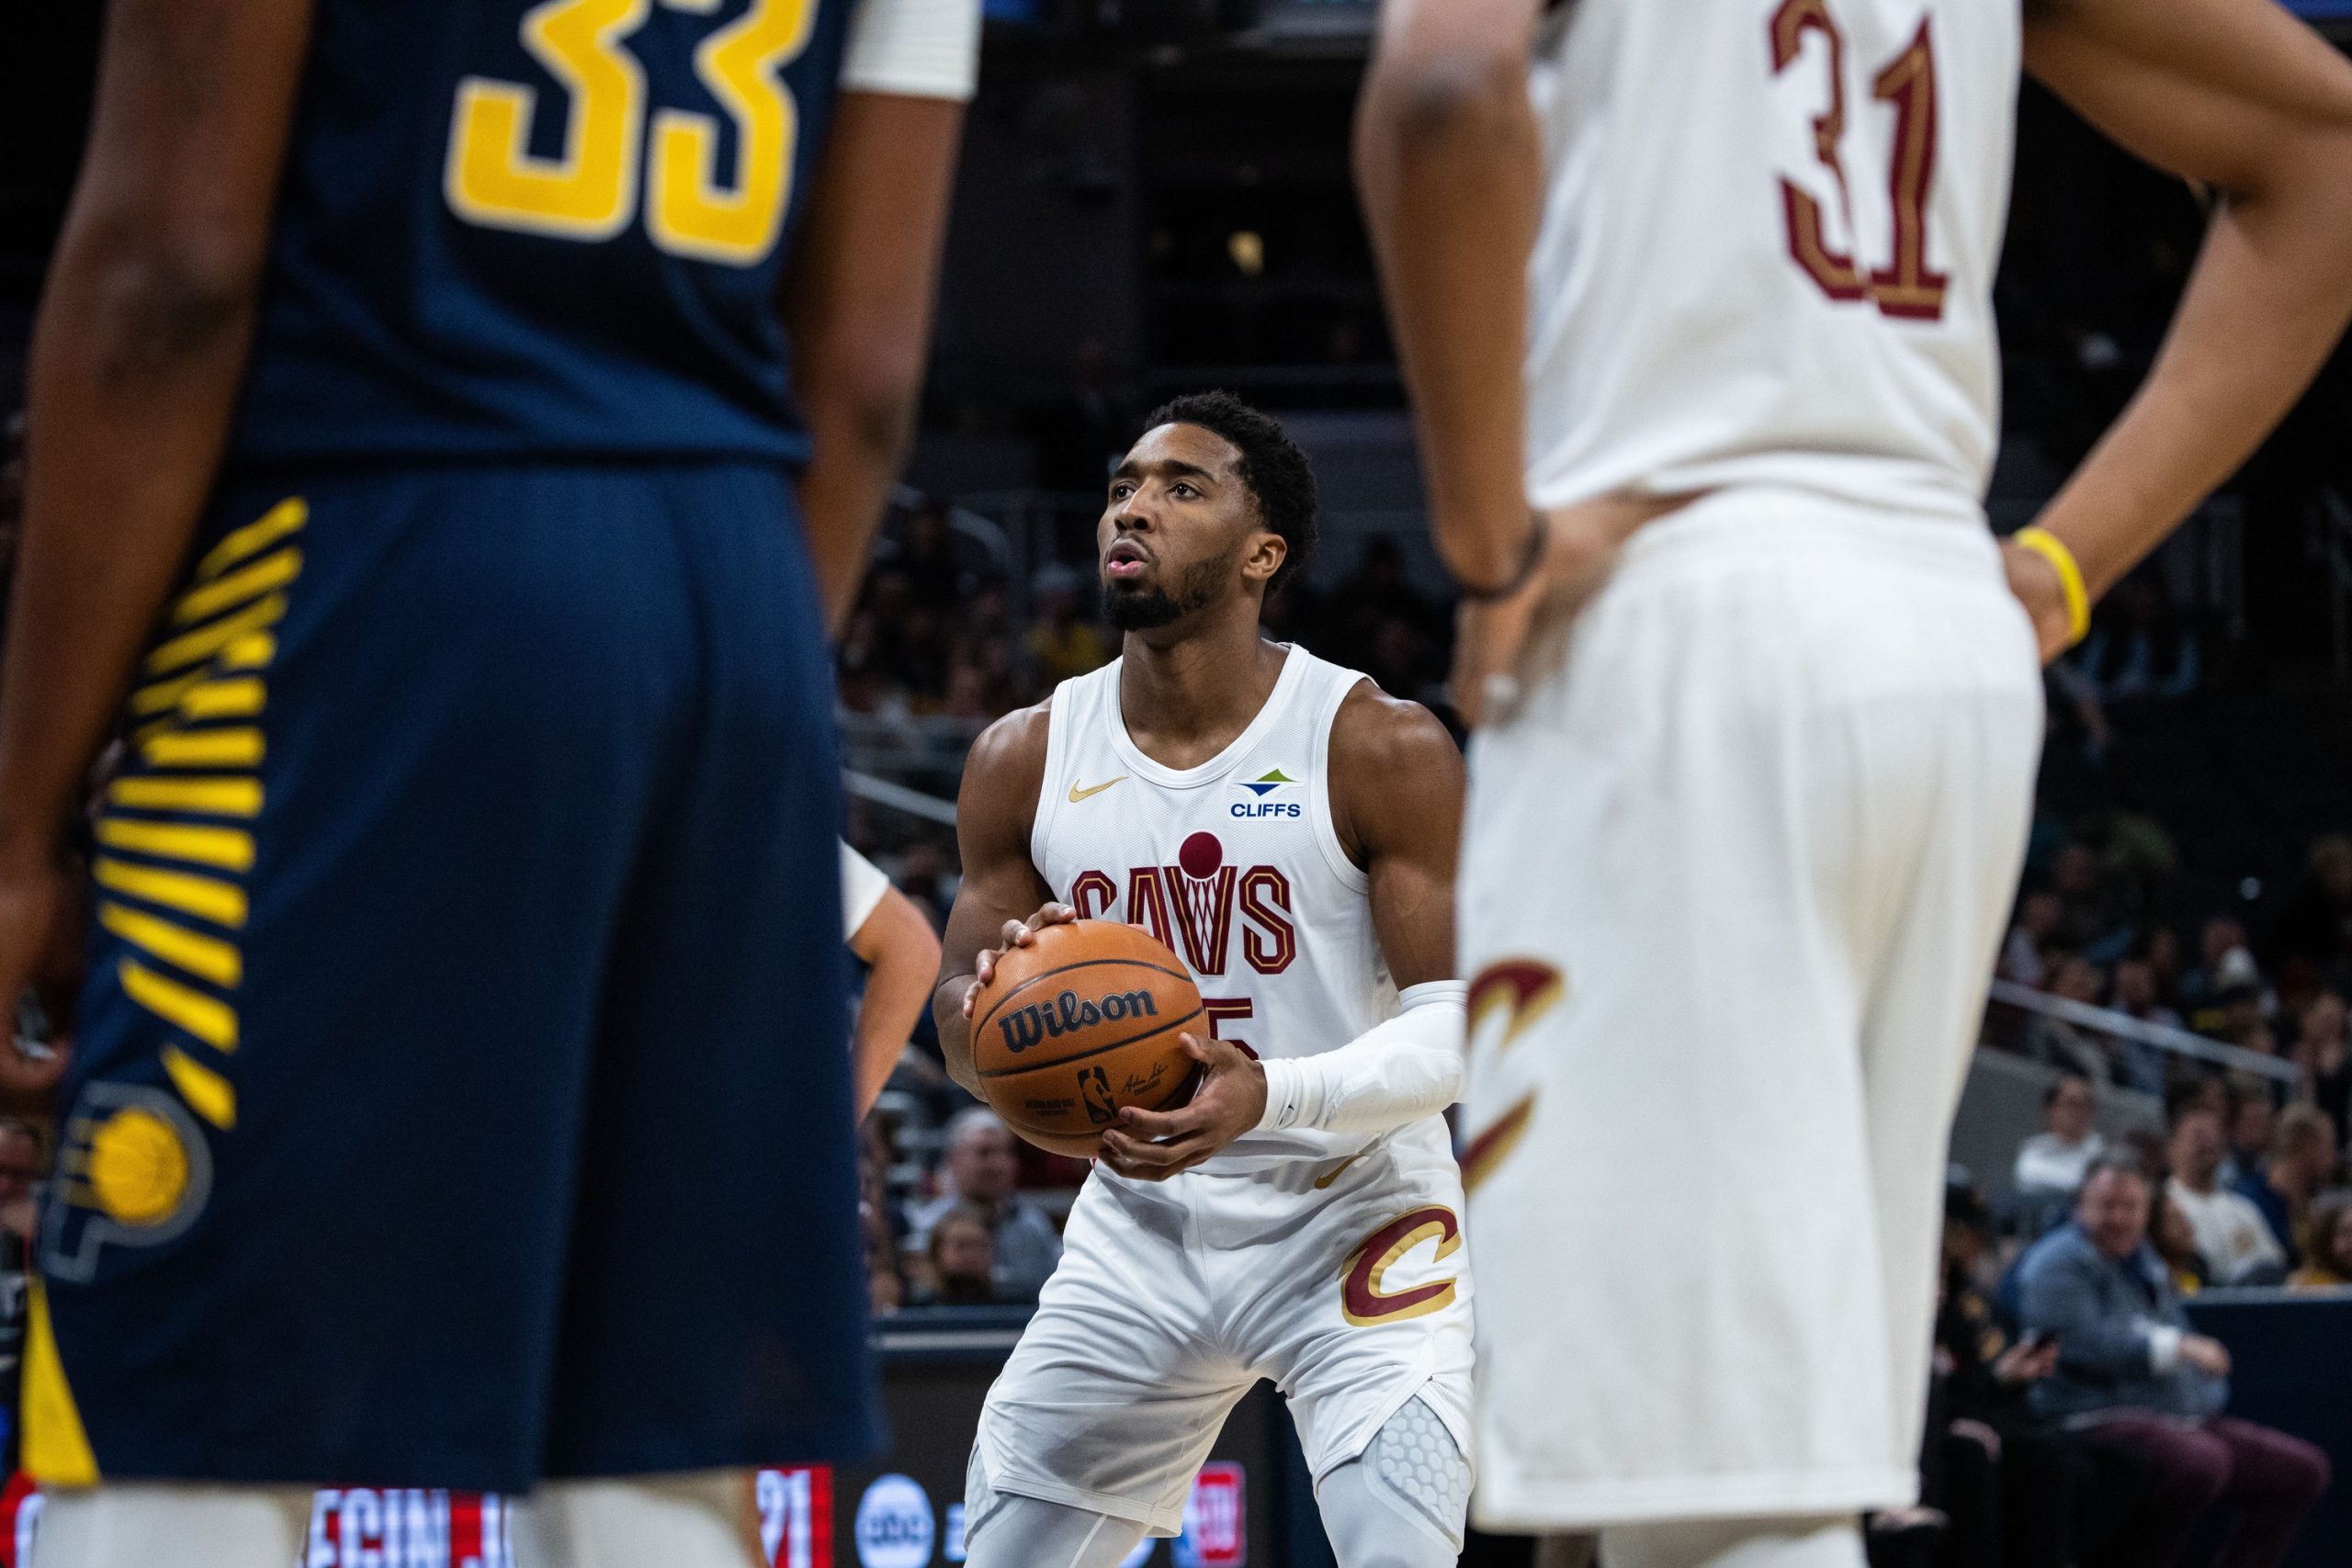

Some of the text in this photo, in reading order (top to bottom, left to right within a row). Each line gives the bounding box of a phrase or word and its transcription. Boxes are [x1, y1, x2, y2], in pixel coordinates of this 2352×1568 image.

[442, 0, 819, 268] 33
[1768, 0, 1949, 321] 31
[1230, 803, 1302, 818] CLIFFS
[998, 988, 1159, 1054] Wilson
